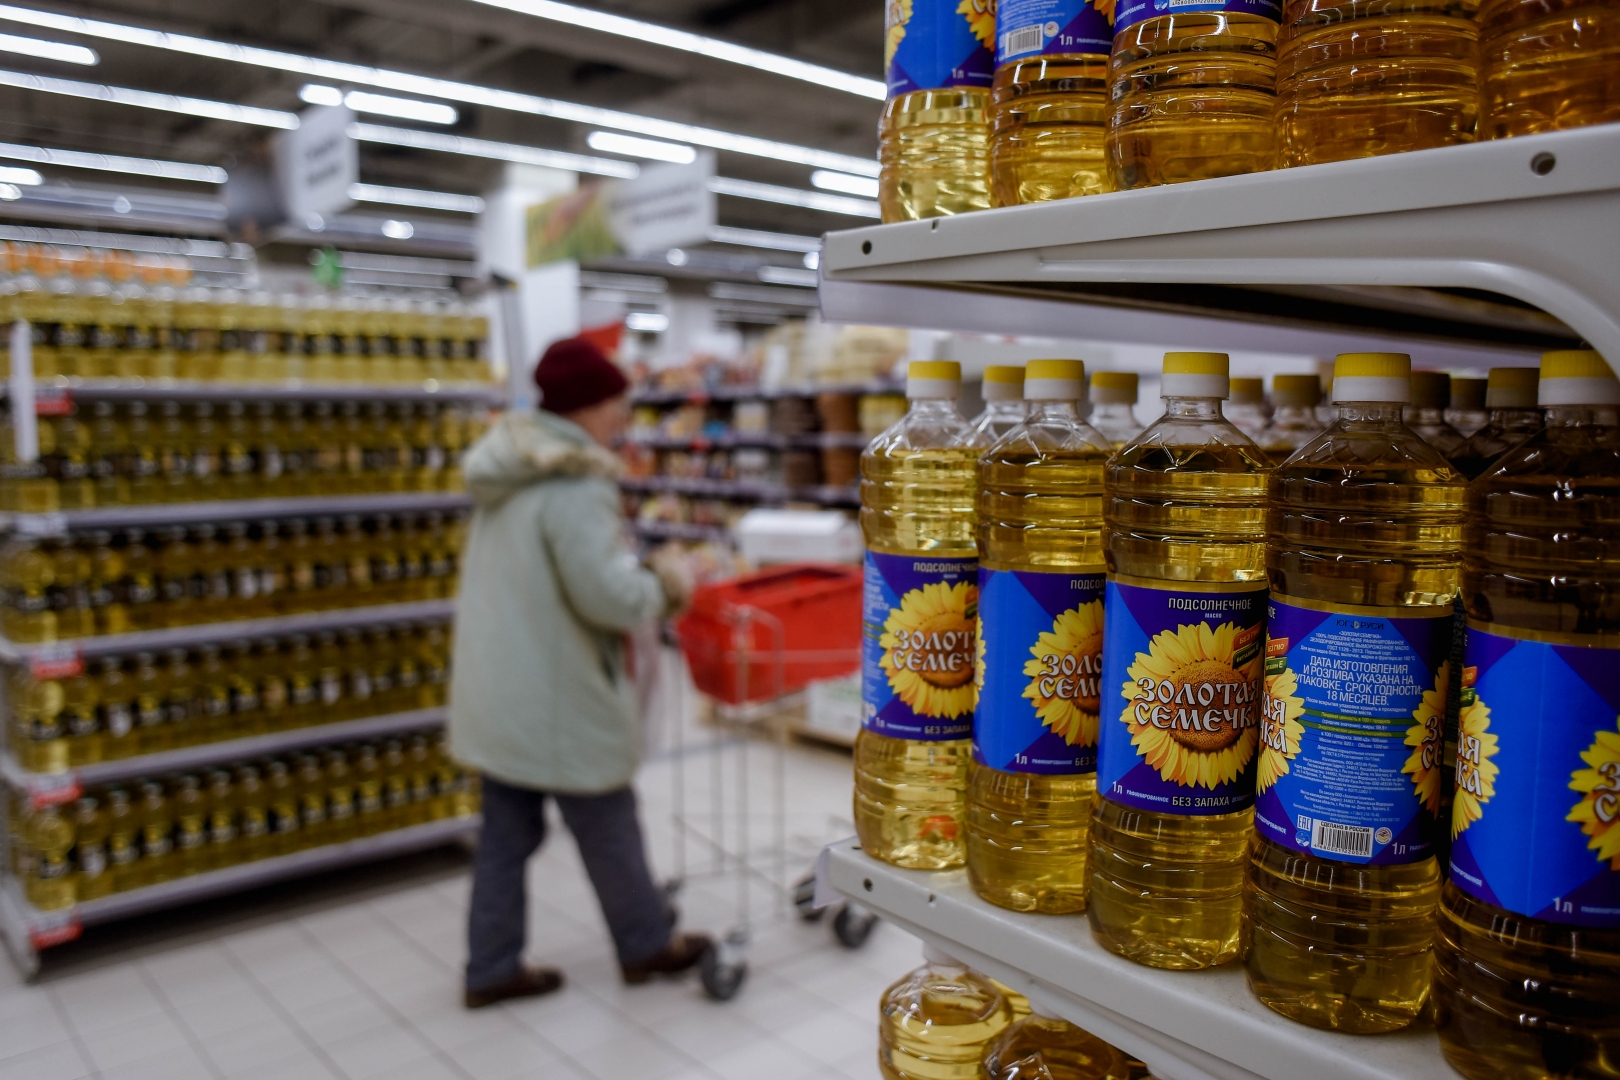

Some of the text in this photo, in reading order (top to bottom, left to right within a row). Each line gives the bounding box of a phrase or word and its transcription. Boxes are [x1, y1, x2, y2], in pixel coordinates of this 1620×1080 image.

[1059, 34, 1073, 46] 1л
[913, 561, 978, 573] ПОДСОЛНЕЧНО
[1070, 578, 1106, 590] ПОДСОЛ
[1168, 597, 1252, 611] ПОДСОЛНЕЧНОЕ
[1361, 621, 1384, 630] РУСИ
[892, 629, 977, 652] ЗОЛОТ
[1309, 655, 1409, 675] ДАТА ИЗГОТОВЛЕНИЯ
[1303, 664, 1414, 685] И РОЗЛИВА УКАЗАНА НА
[1134, 677, 1261, 707] ЗОЛОТАЯ
[1295, 673, 1422, 697] УПАКОВКЕ. СРОК ГОДНОСТИ:
[1326, 689, 1390, 706] 18 МЕСЯЦЕВ.
[1262, 691, 1287, 725] АЯ
[1134, 702, 1261, 732] СЕМЕЧКА
[924, 725, 941, 734] БЕЗ
[1015, 752, 1028, 765] 1л
[1075, 757, 1090, 767] БЕЗ
[1112, 780, 1123, 795] 1л
[1171, 796, 1192, 808] БЕЗ
[1194, 796, 1230, 808] ЗАПАХА
[1320, 821, 1344, 830] СДЕЛАНО
[1391, 841, 1406, 855] 1л
[1552, 896, 1574, 914] 1л
